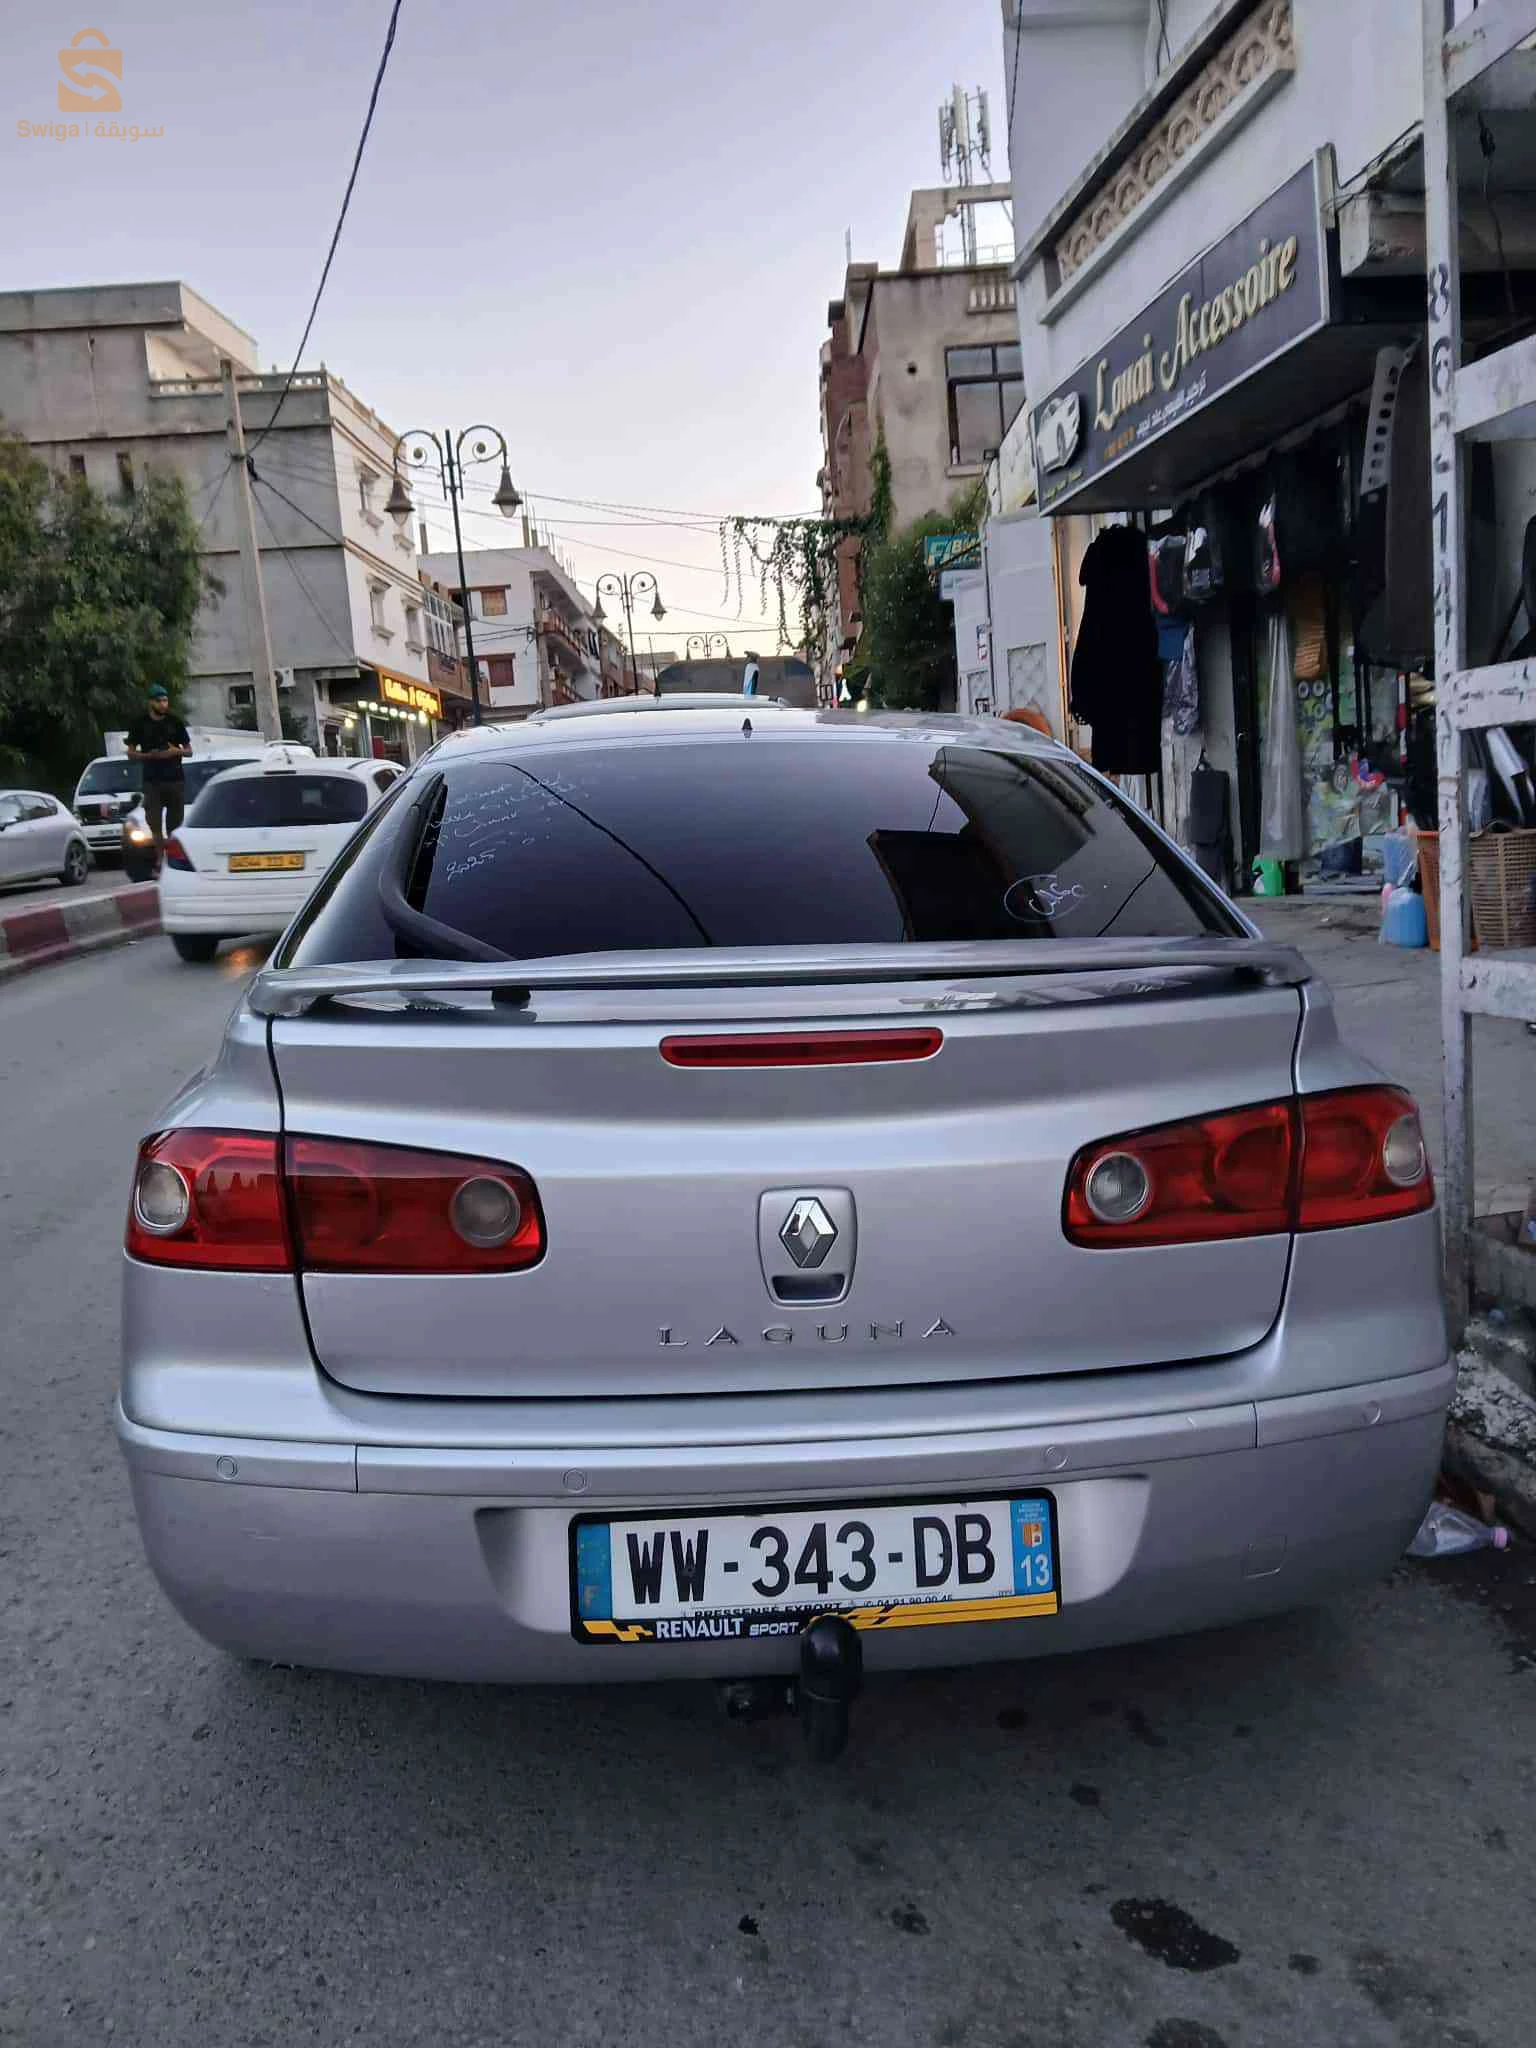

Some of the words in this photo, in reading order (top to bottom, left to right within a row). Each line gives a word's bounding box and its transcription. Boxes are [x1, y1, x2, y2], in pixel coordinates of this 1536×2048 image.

[1094, 334, 1154, 431] Louai
[1159, 236, 1297, 391] Accessoire
[656, 1316, 956, 1346] LAGUNA
[1020, 1553, 1050, 1587] 13
[655, 1617, 744, 1639] RENAULT
[749, 1620, 799, 1637] SPORT
